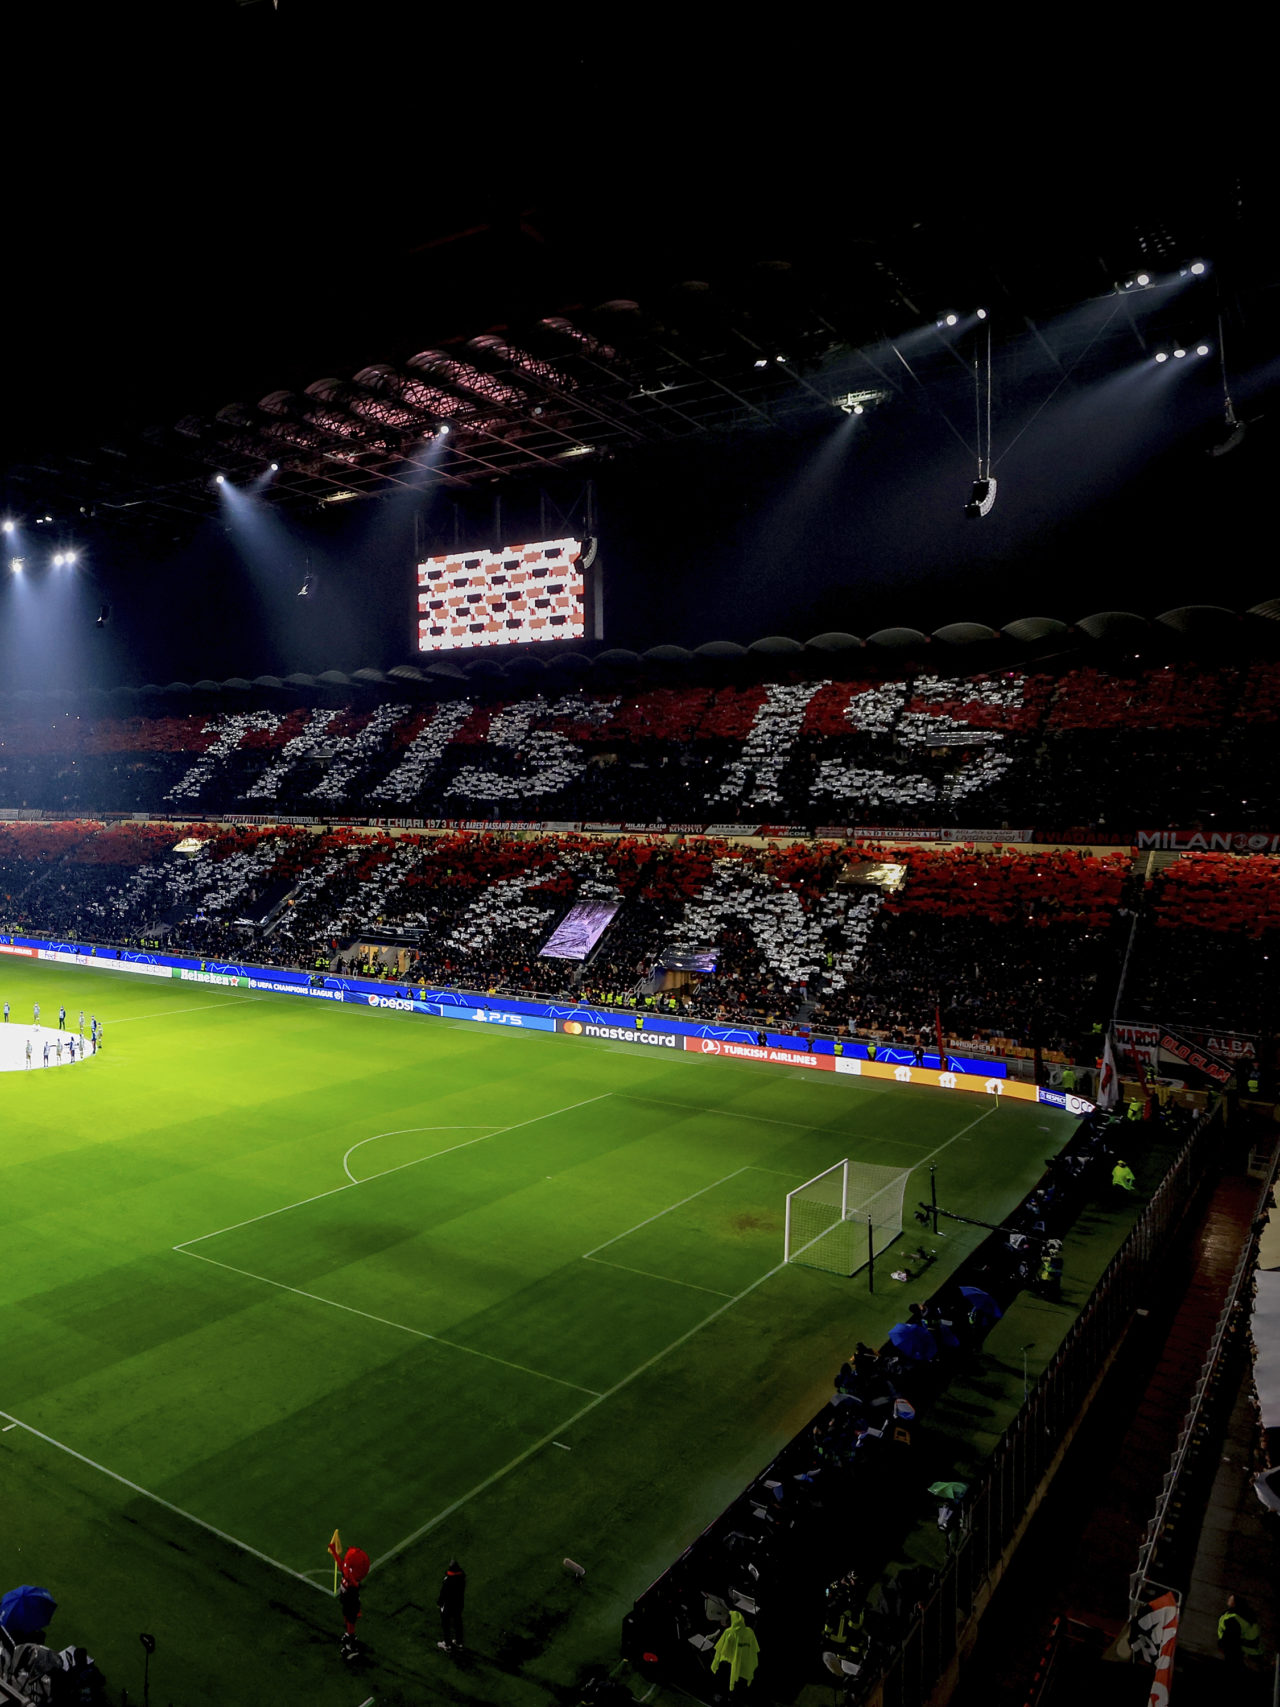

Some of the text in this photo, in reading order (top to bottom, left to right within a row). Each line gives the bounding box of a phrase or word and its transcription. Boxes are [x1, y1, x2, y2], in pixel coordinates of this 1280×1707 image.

[425, 819, 447, 829] 1973
[1138, 830, 1233, 850] MILAN
[181, 968, 230, 985] Heineken
[257, 981, 333, 998] UEFA CHAMPIONS LEAGUE
[380, 997, 414, 1011] pepsi
[489, 1012, 523, 1025] PS5
[585, 1024, 676, 1047] mastercard
[1116, 1028, 1158, 1047] MARCO
[1207, 1037, 1257, 1054] ALBA
[723, 1044, 817, 1066] TURKISH AIRLINES
[1160, 1035, 1191, 1060] OLD
[1187, 1052, 1231, 1084] CLAN
